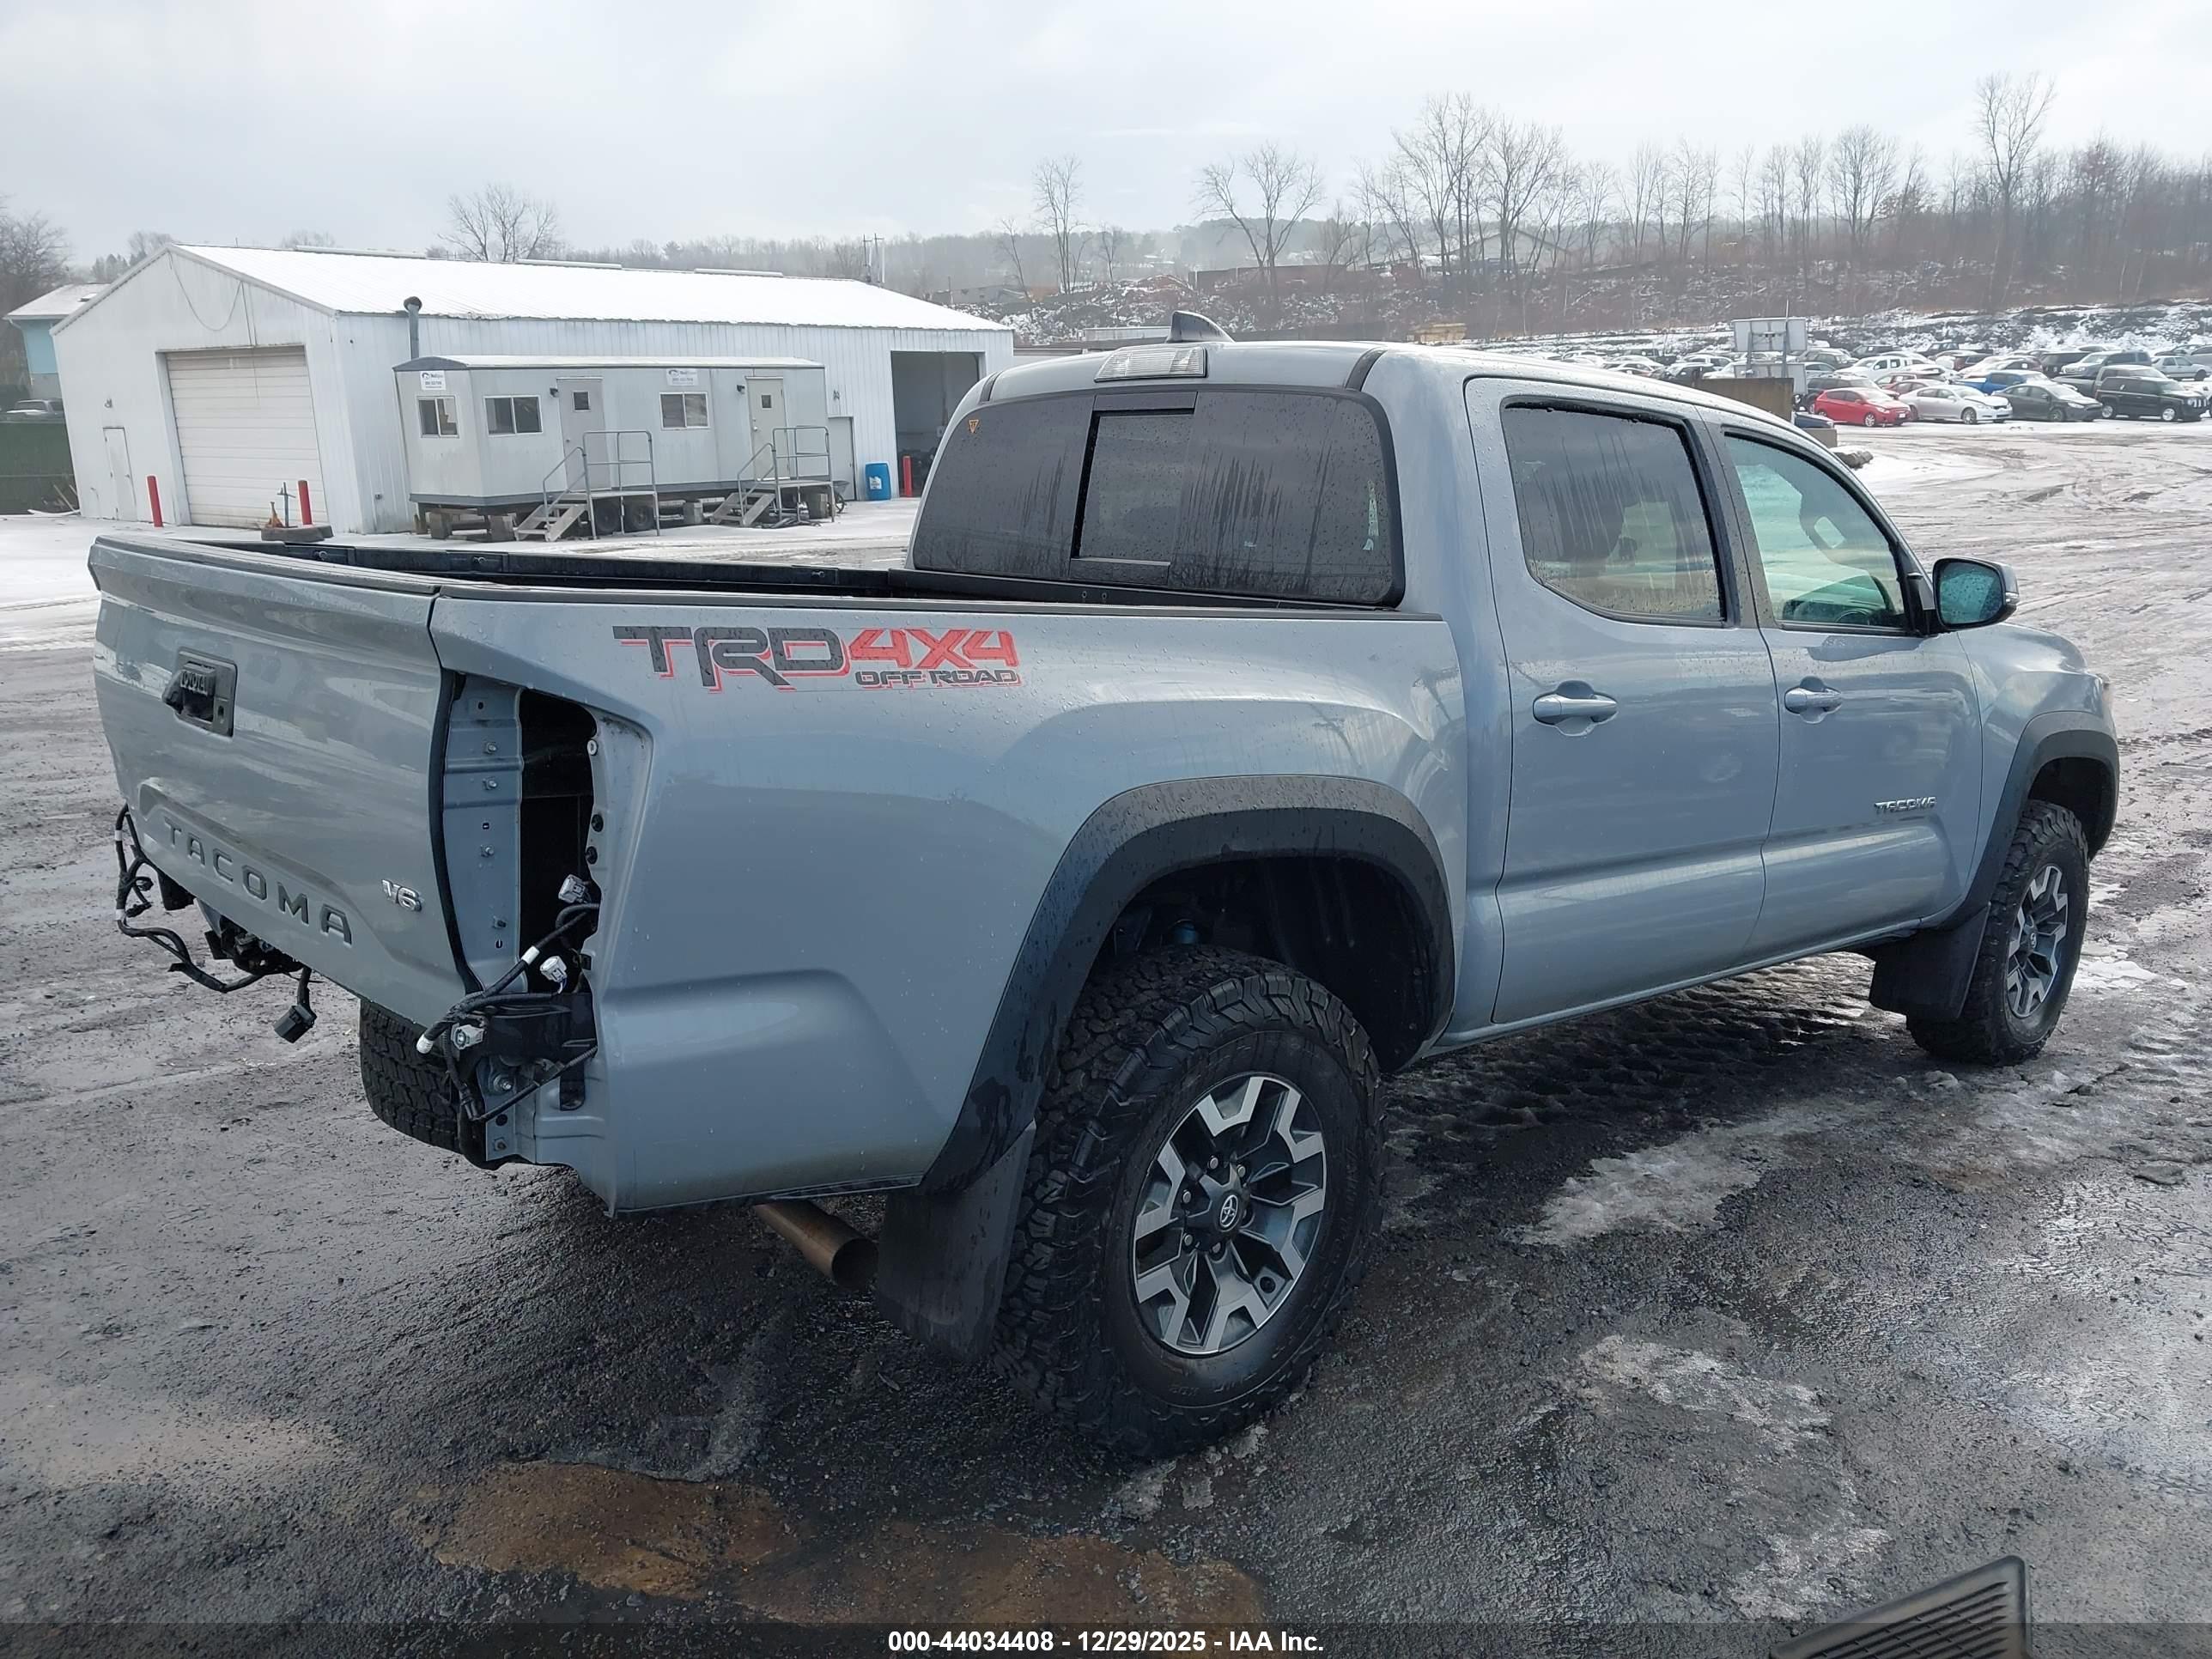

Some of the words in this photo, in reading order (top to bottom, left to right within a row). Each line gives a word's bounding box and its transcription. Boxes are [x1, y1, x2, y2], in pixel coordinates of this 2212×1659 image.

[612, 626, 850, 692] TRD
[849, 628, 1019, 670] 4X4
[855, 669, 927, 688] OFF
[929, 669, 1022, 689] ROAD
[163, 816, 353, 946] TACOMA
[381, 878, 422, 912] V6
